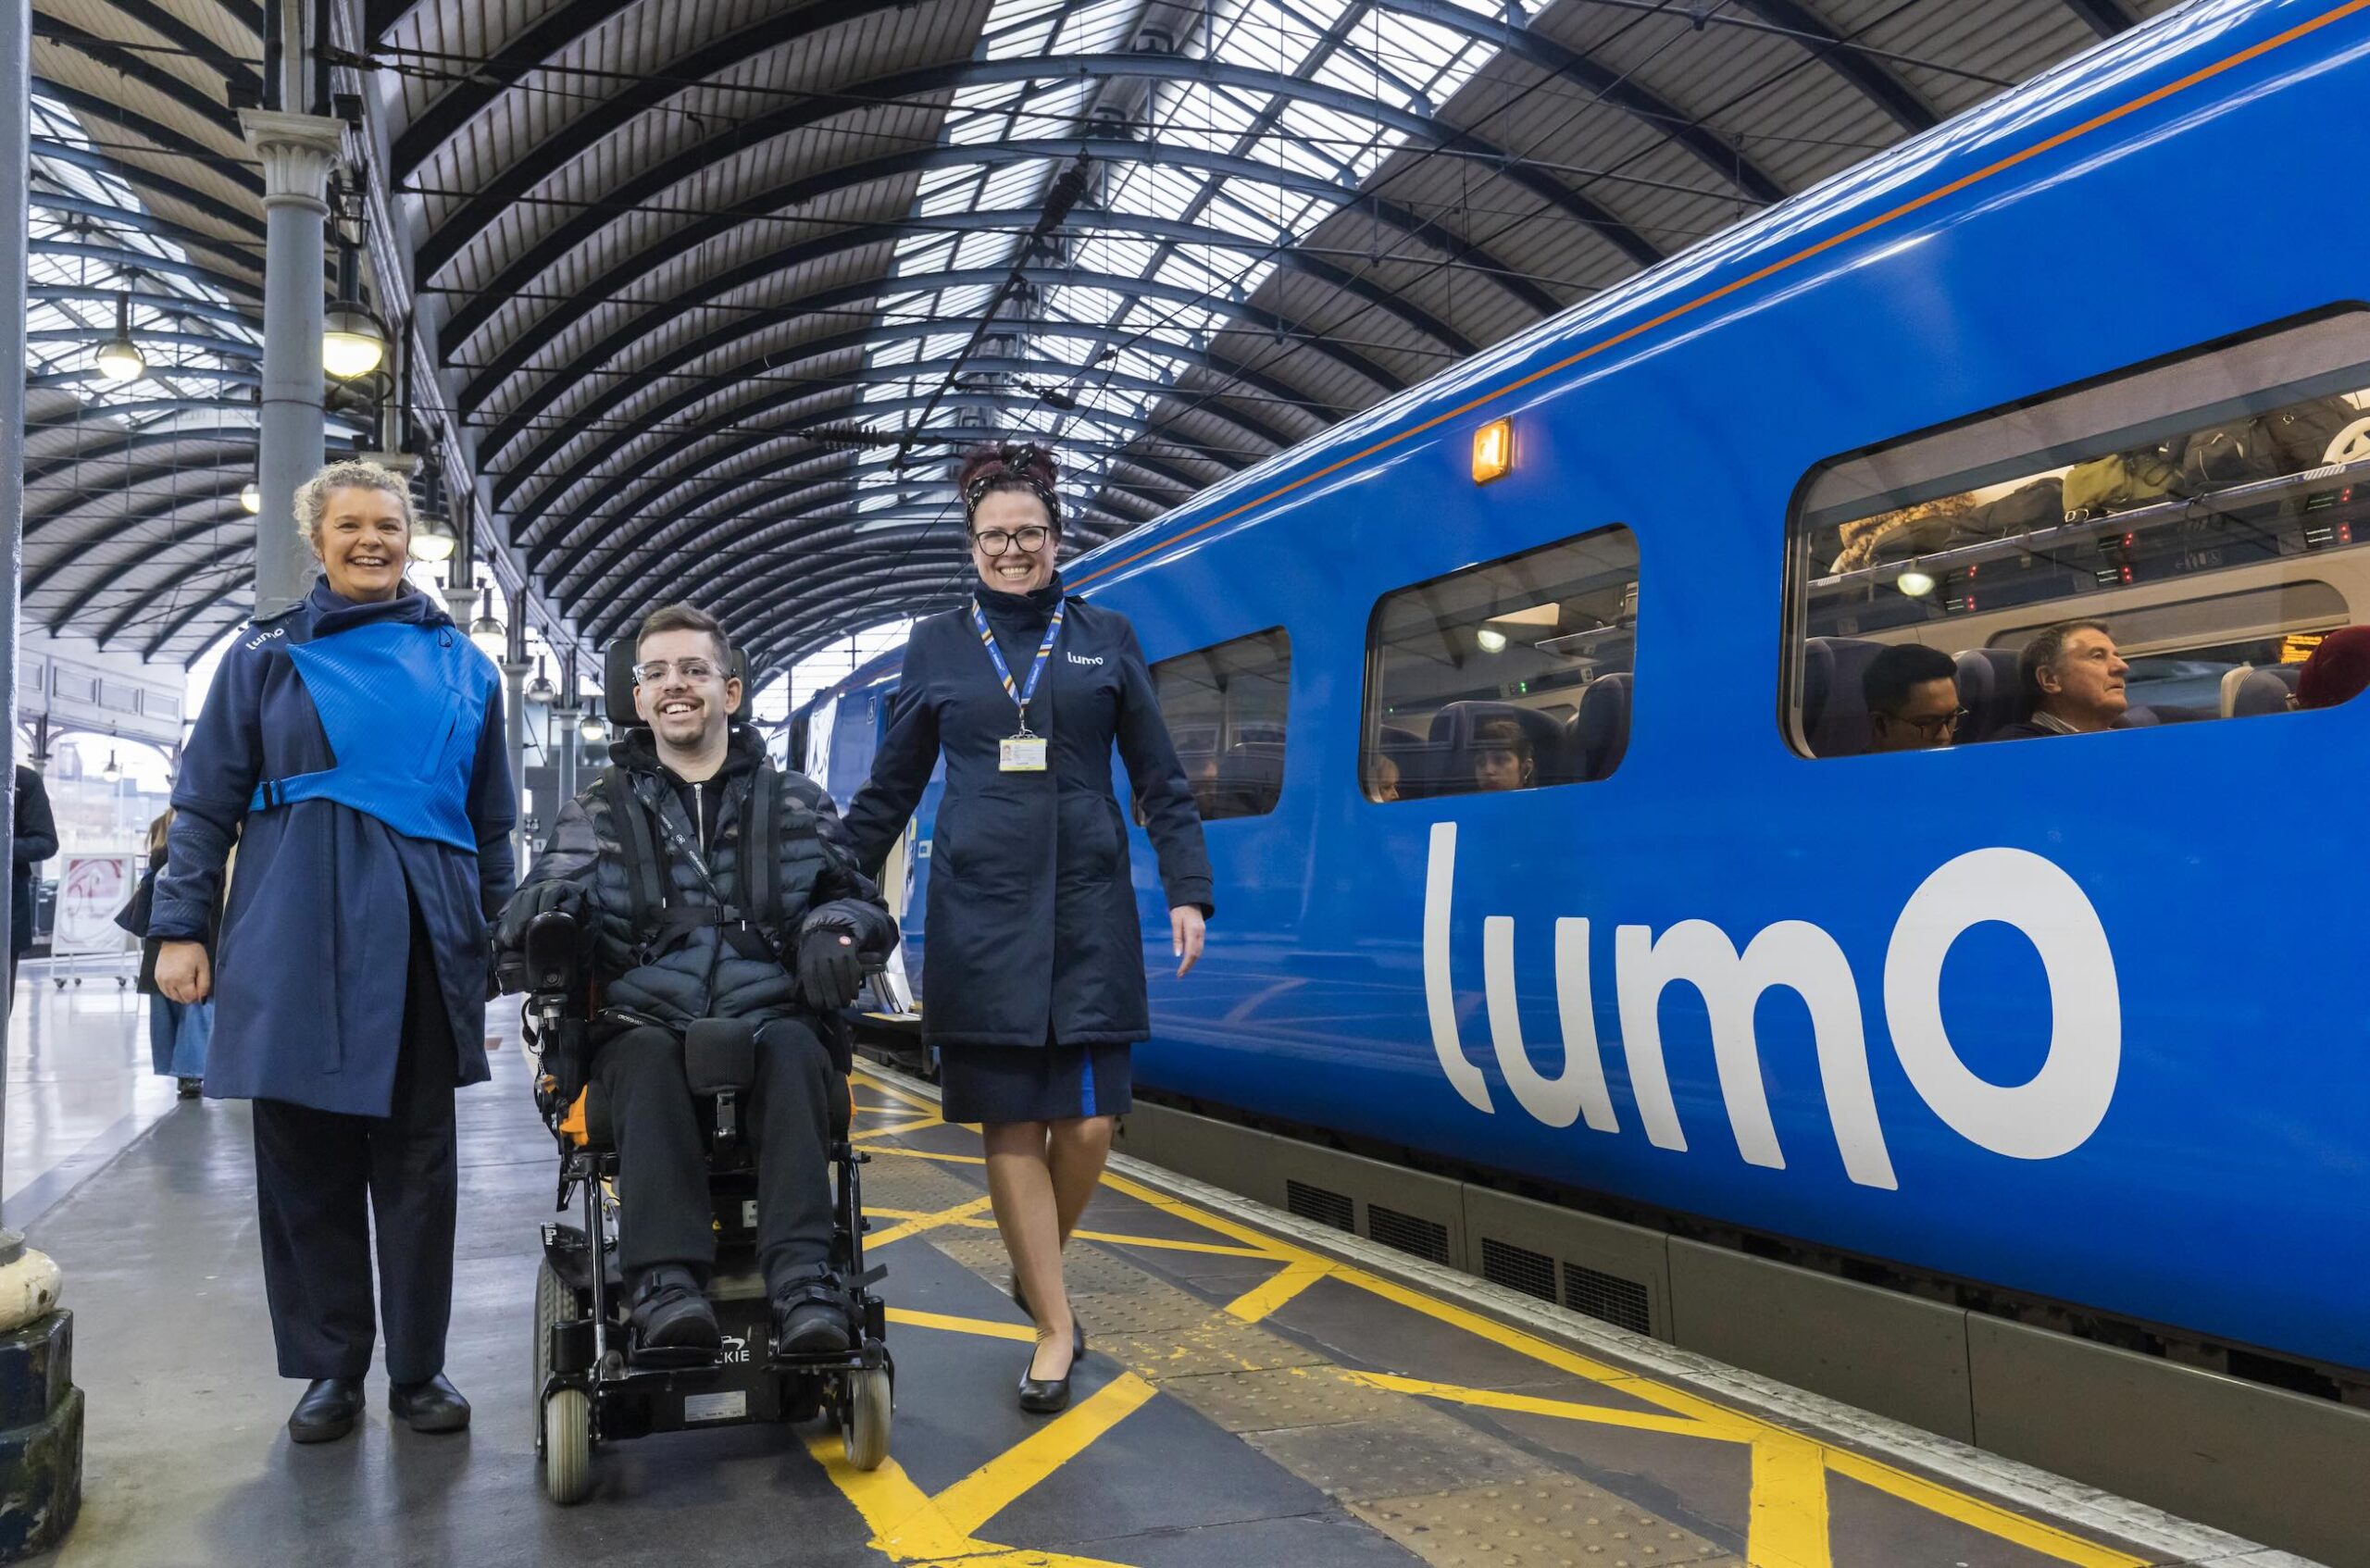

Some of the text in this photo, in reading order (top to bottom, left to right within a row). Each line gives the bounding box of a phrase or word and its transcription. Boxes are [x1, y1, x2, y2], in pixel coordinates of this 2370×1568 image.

[245, 628, 285, 651] lumo
[1067, 651, 1104, 666] lumo
[1422, 820, 2123, 1191] lumo
